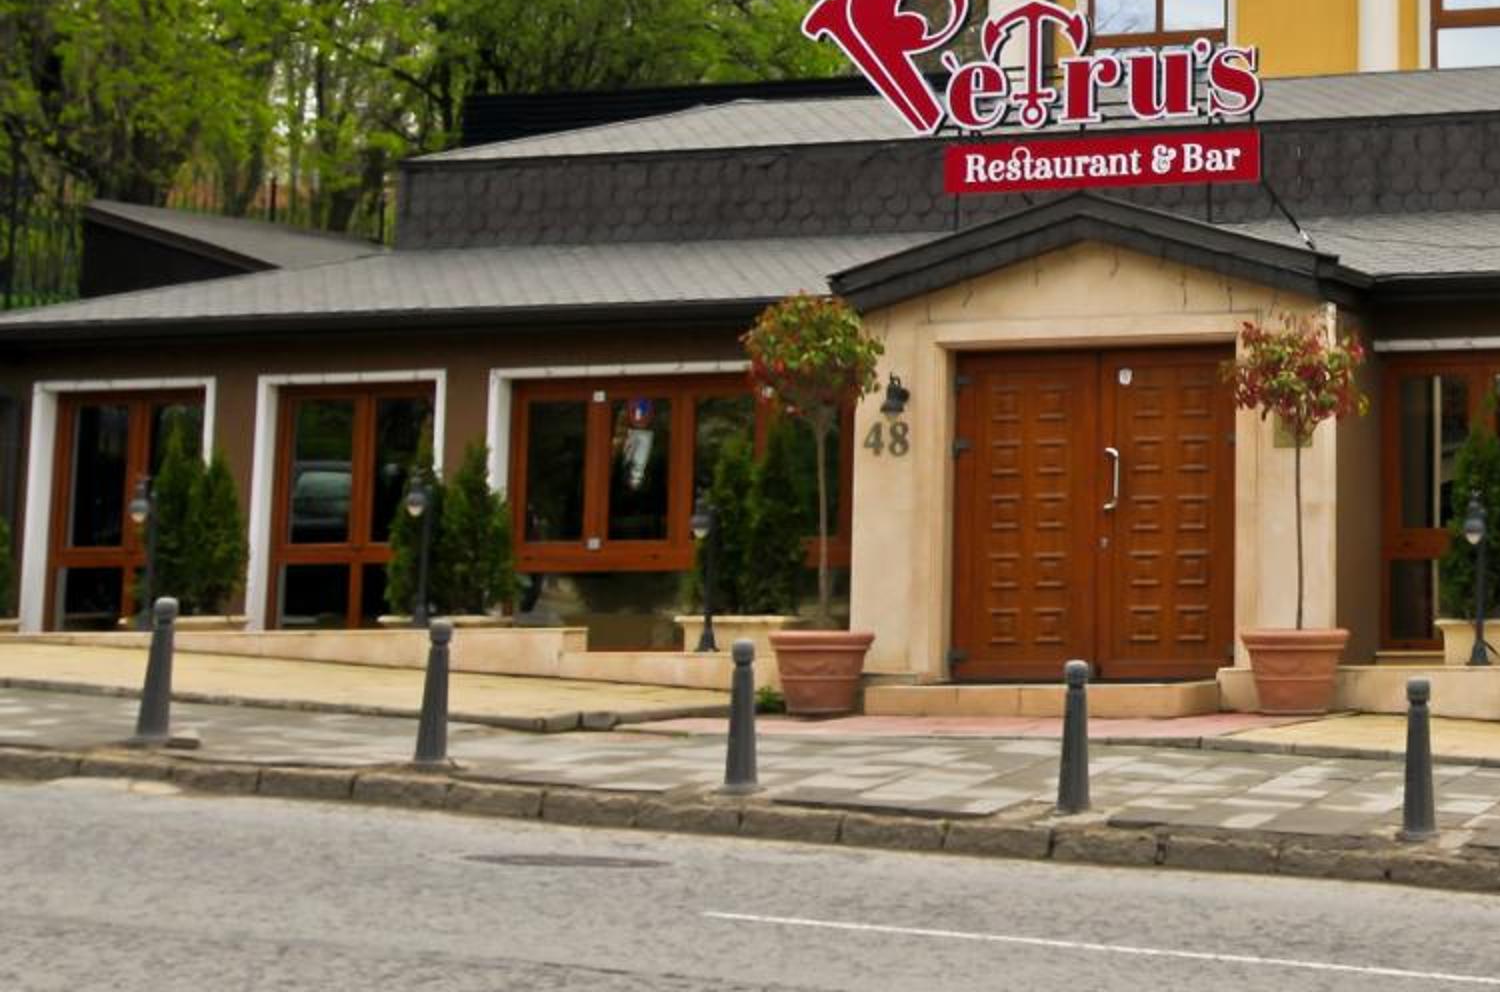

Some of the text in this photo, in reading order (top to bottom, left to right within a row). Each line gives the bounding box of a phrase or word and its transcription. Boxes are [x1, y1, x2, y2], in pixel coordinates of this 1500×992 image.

[965, 143, 1241, 183] Restaurant & Bar
[863, 421, 910, 457] 48
